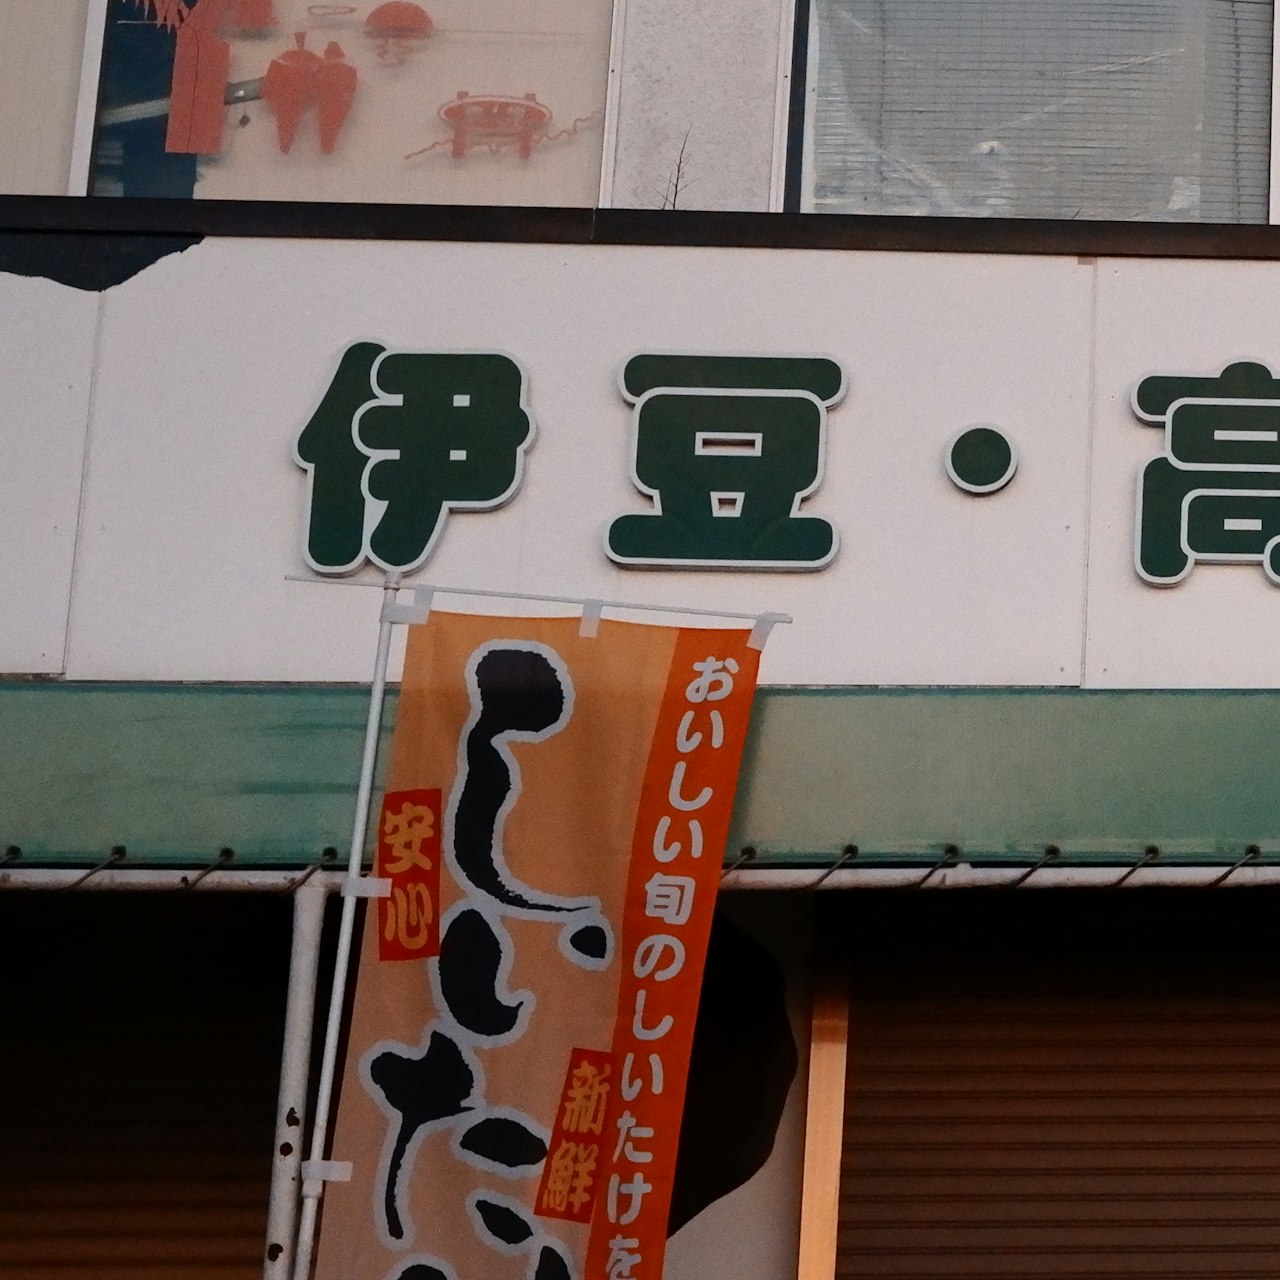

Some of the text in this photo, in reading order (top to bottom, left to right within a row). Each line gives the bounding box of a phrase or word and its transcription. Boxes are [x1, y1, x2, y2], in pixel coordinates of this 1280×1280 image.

[382, 802, 435, 951] 安心
[360, 638, 616, 1280] しいた
[541, 1058, 611, 1214] 新鮮
